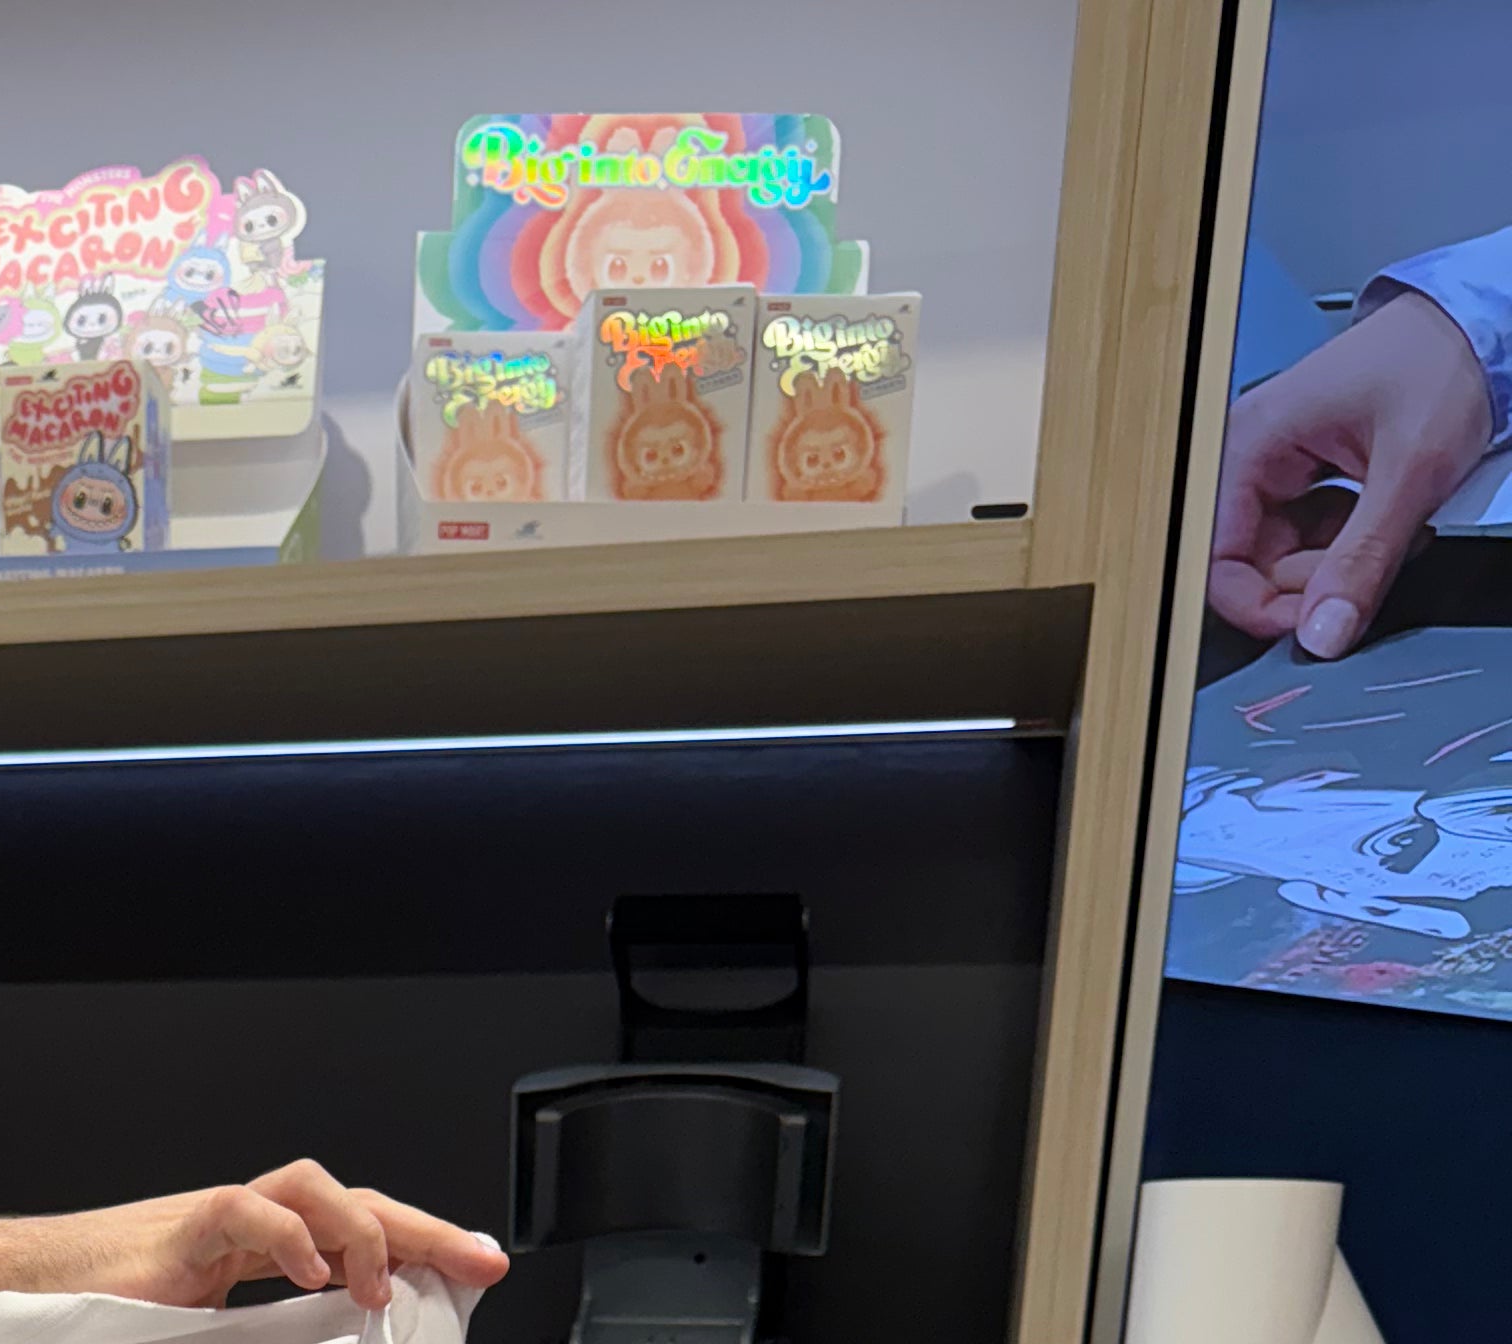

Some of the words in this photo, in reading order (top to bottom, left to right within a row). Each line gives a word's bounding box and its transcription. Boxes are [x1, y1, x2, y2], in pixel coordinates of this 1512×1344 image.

[461, 122, 576, 208] Big
[579, 144, 662, 187] into
[663, 127, 831, 208] Energy
[762, 314, 838, 358] Big
[20, 368, 134, 422] EXCITING
[8, 408, 121, 446] MACARON
